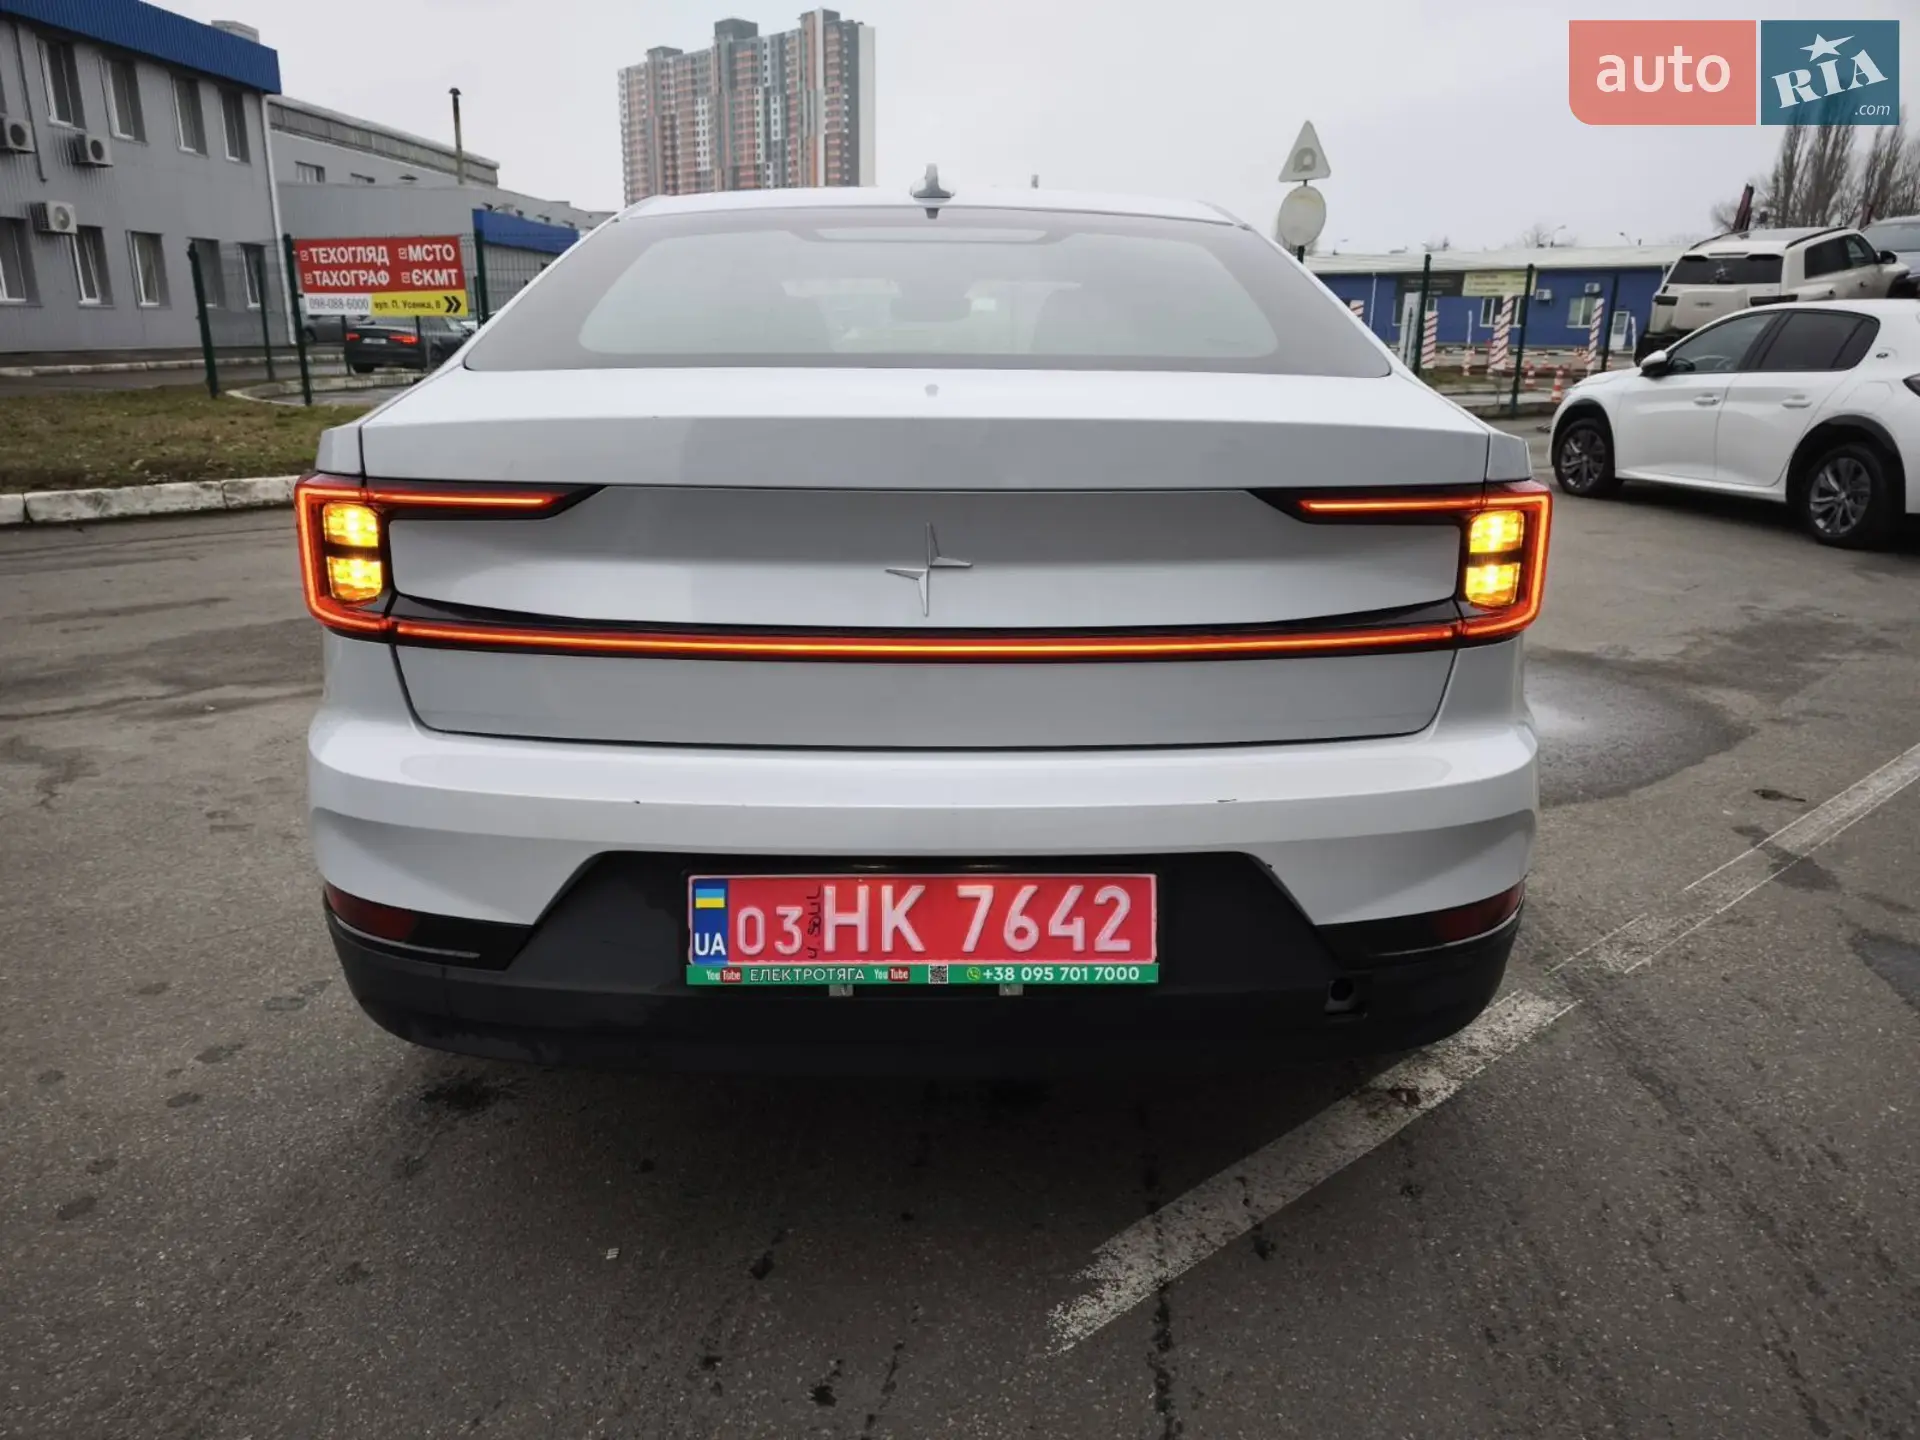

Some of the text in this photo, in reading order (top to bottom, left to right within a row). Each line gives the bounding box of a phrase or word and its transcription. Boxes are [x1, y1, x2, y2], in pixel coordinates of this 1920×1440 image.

[309, 245, 390, 266] ТЕХОГЛЯД
[408, 244, 455, 262] МСТО
[312, 269, 390, 286] ТАХОГРАФ
[412, 268, 458, 286] ЄКМТ
[736, 906, 804, 956] 03
[957, 884, 1132, 953] 7642
[694, 932, 727, 956] UA
[750, 968, 866, 983] ЕЛЕКТРОТЯГА
[983, 966, 1140, 981] +38 095 701 7000
